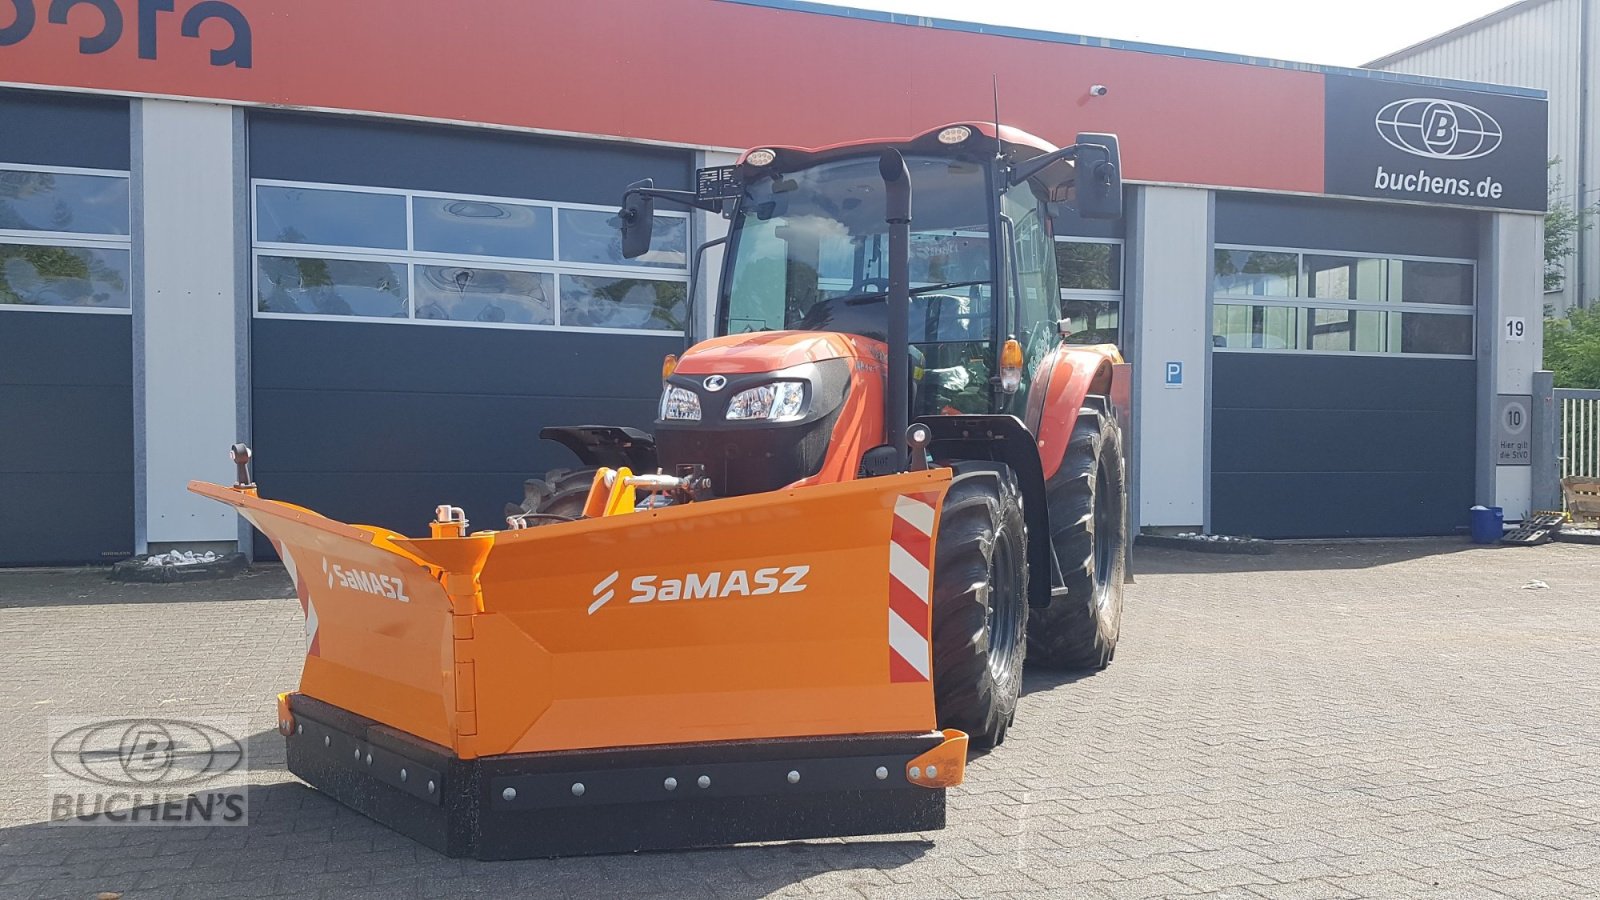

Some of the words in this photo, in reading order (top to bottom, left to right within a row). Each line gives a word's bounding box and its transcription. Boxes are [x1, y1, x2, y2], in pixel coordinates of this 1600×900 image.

[1374, 166, 1503, 199] buchens.de
[1506, 320, 1524, 337] 19
[1167, 363, 1180, 382] P
[1508, 410, 1521, 426] 10
[1500, 440, 1514, 449] Hier
[333, 564, 410, 603] SaMASZ
[629, 565, 810, 604] SaMASZ
